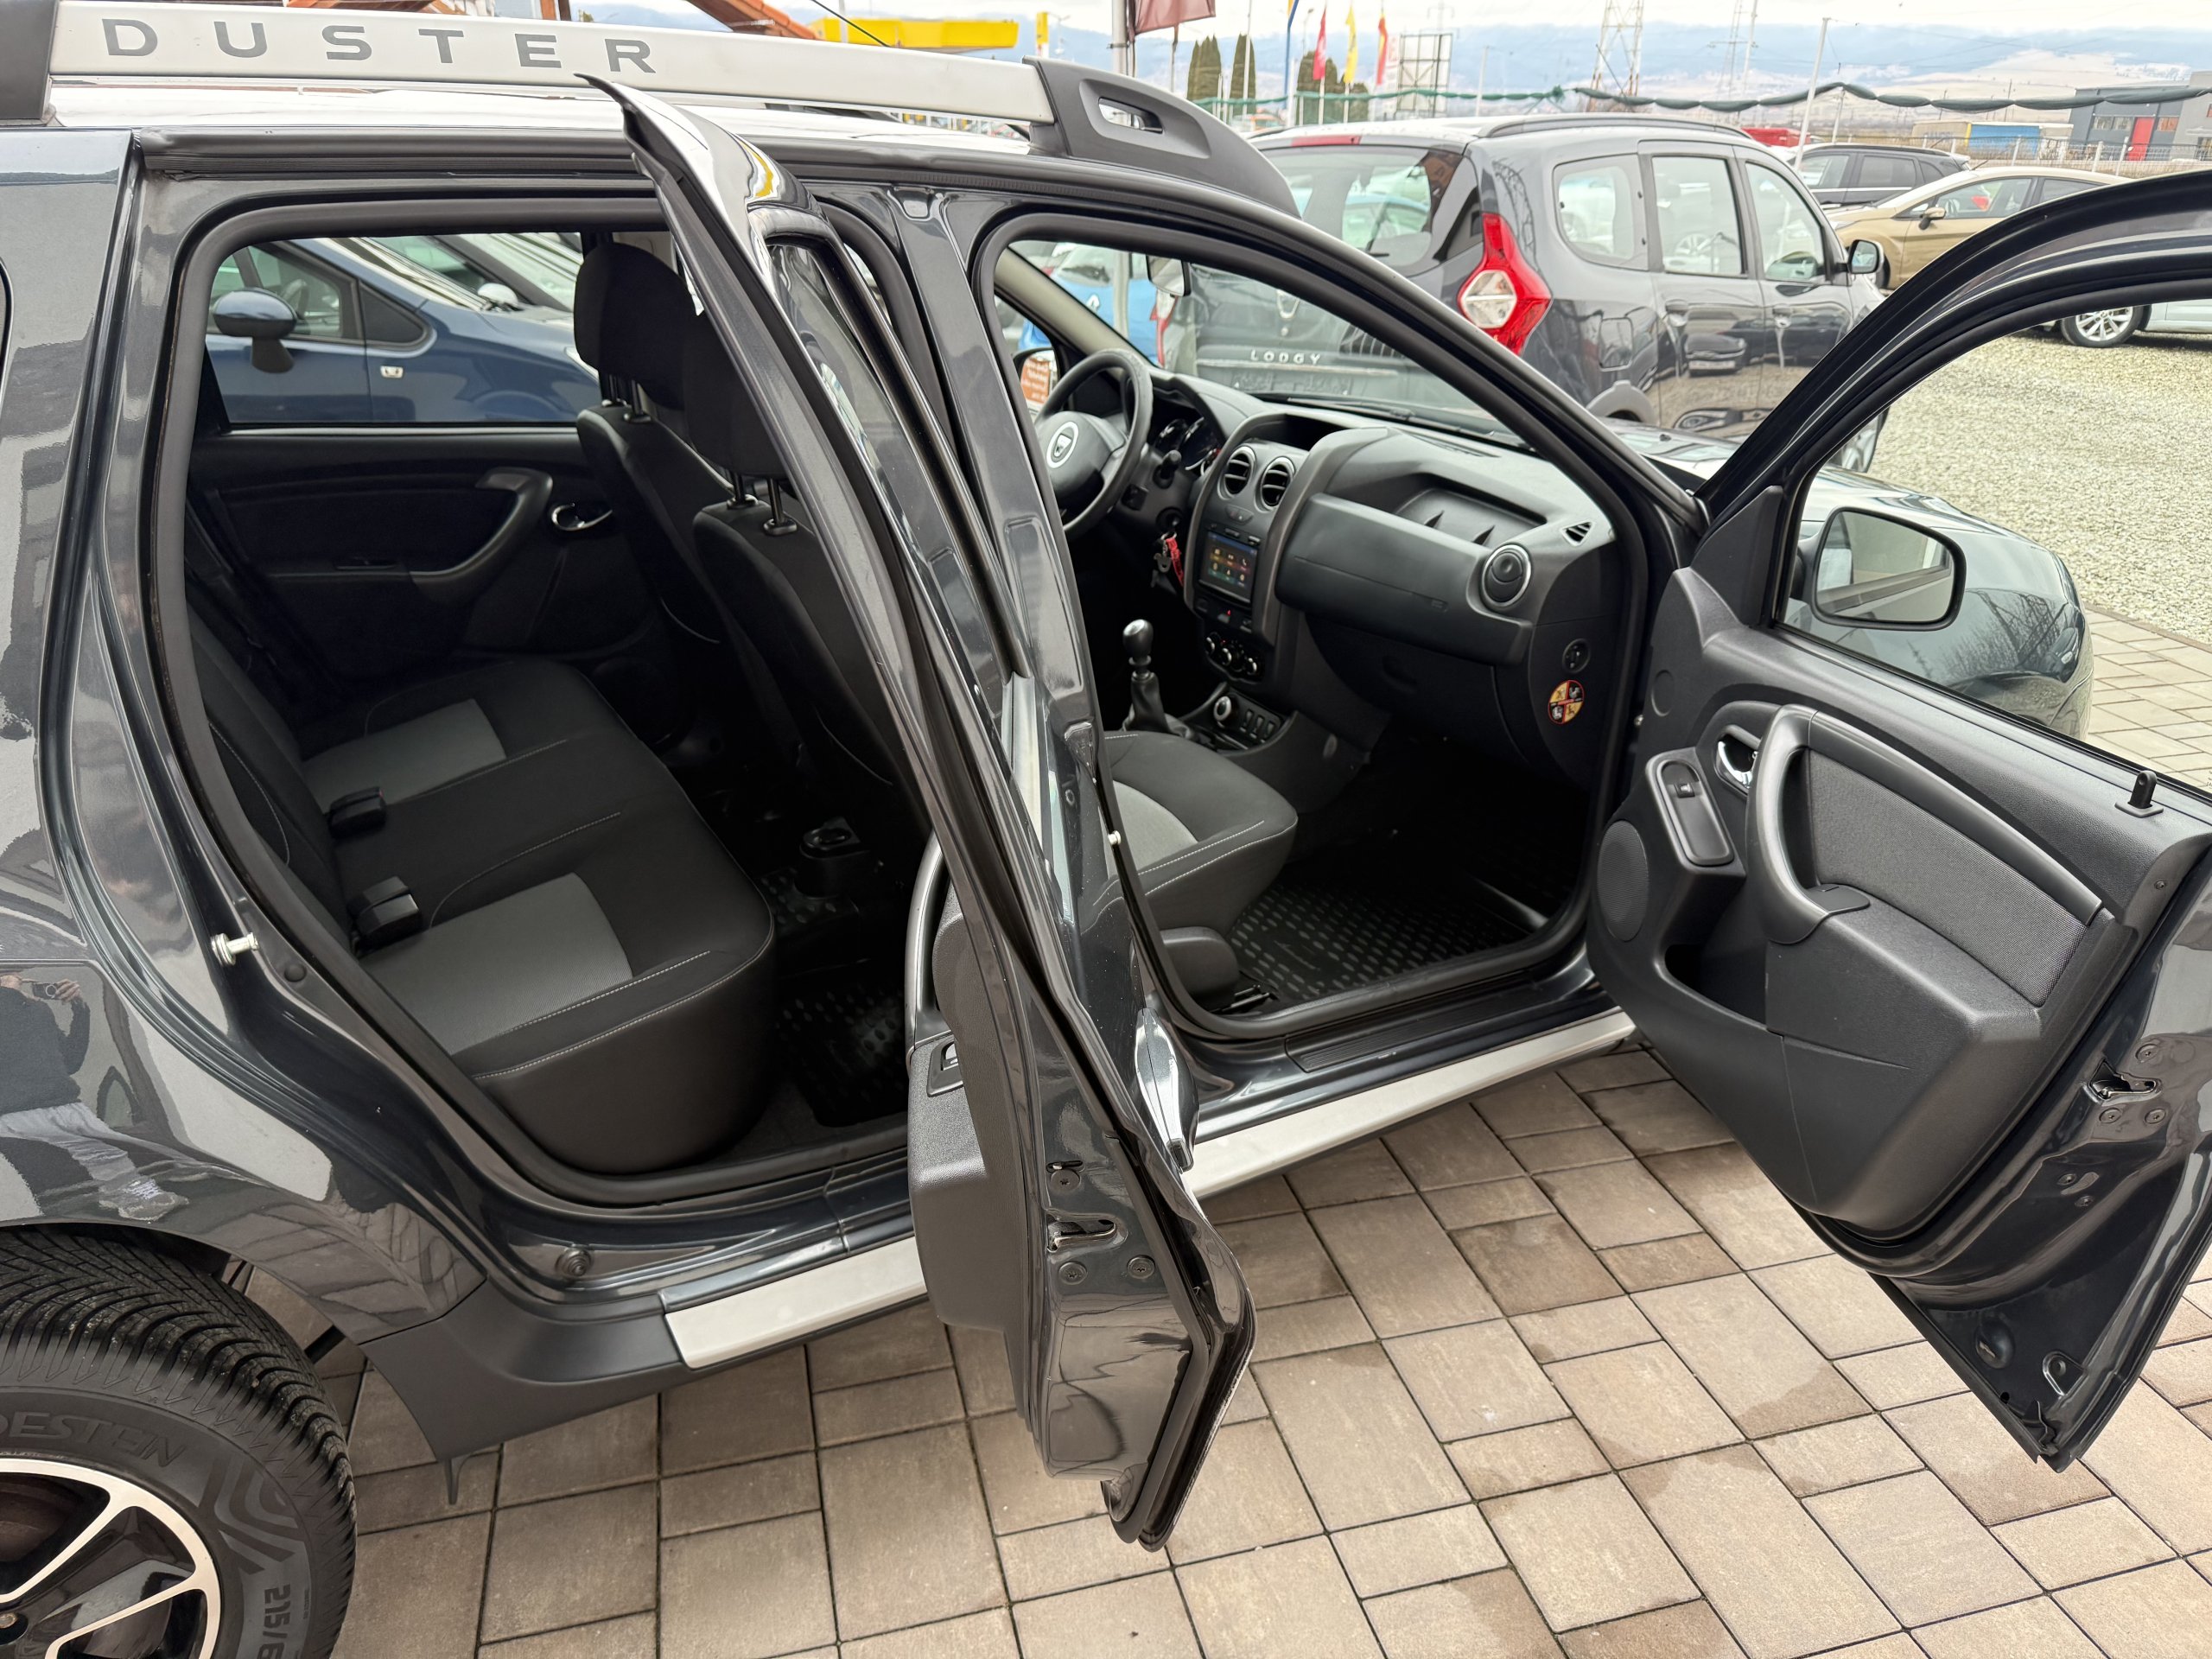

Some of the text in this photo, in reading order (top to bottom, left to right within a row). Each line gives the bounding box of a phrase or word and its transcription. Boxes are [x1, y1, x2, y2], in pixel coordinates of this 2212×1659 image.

[102, 18, 657, 74] DUSTER
[1250, 349, 1321, 365] LODGY
[0, 1410, 187, 1468] ESTEIN
